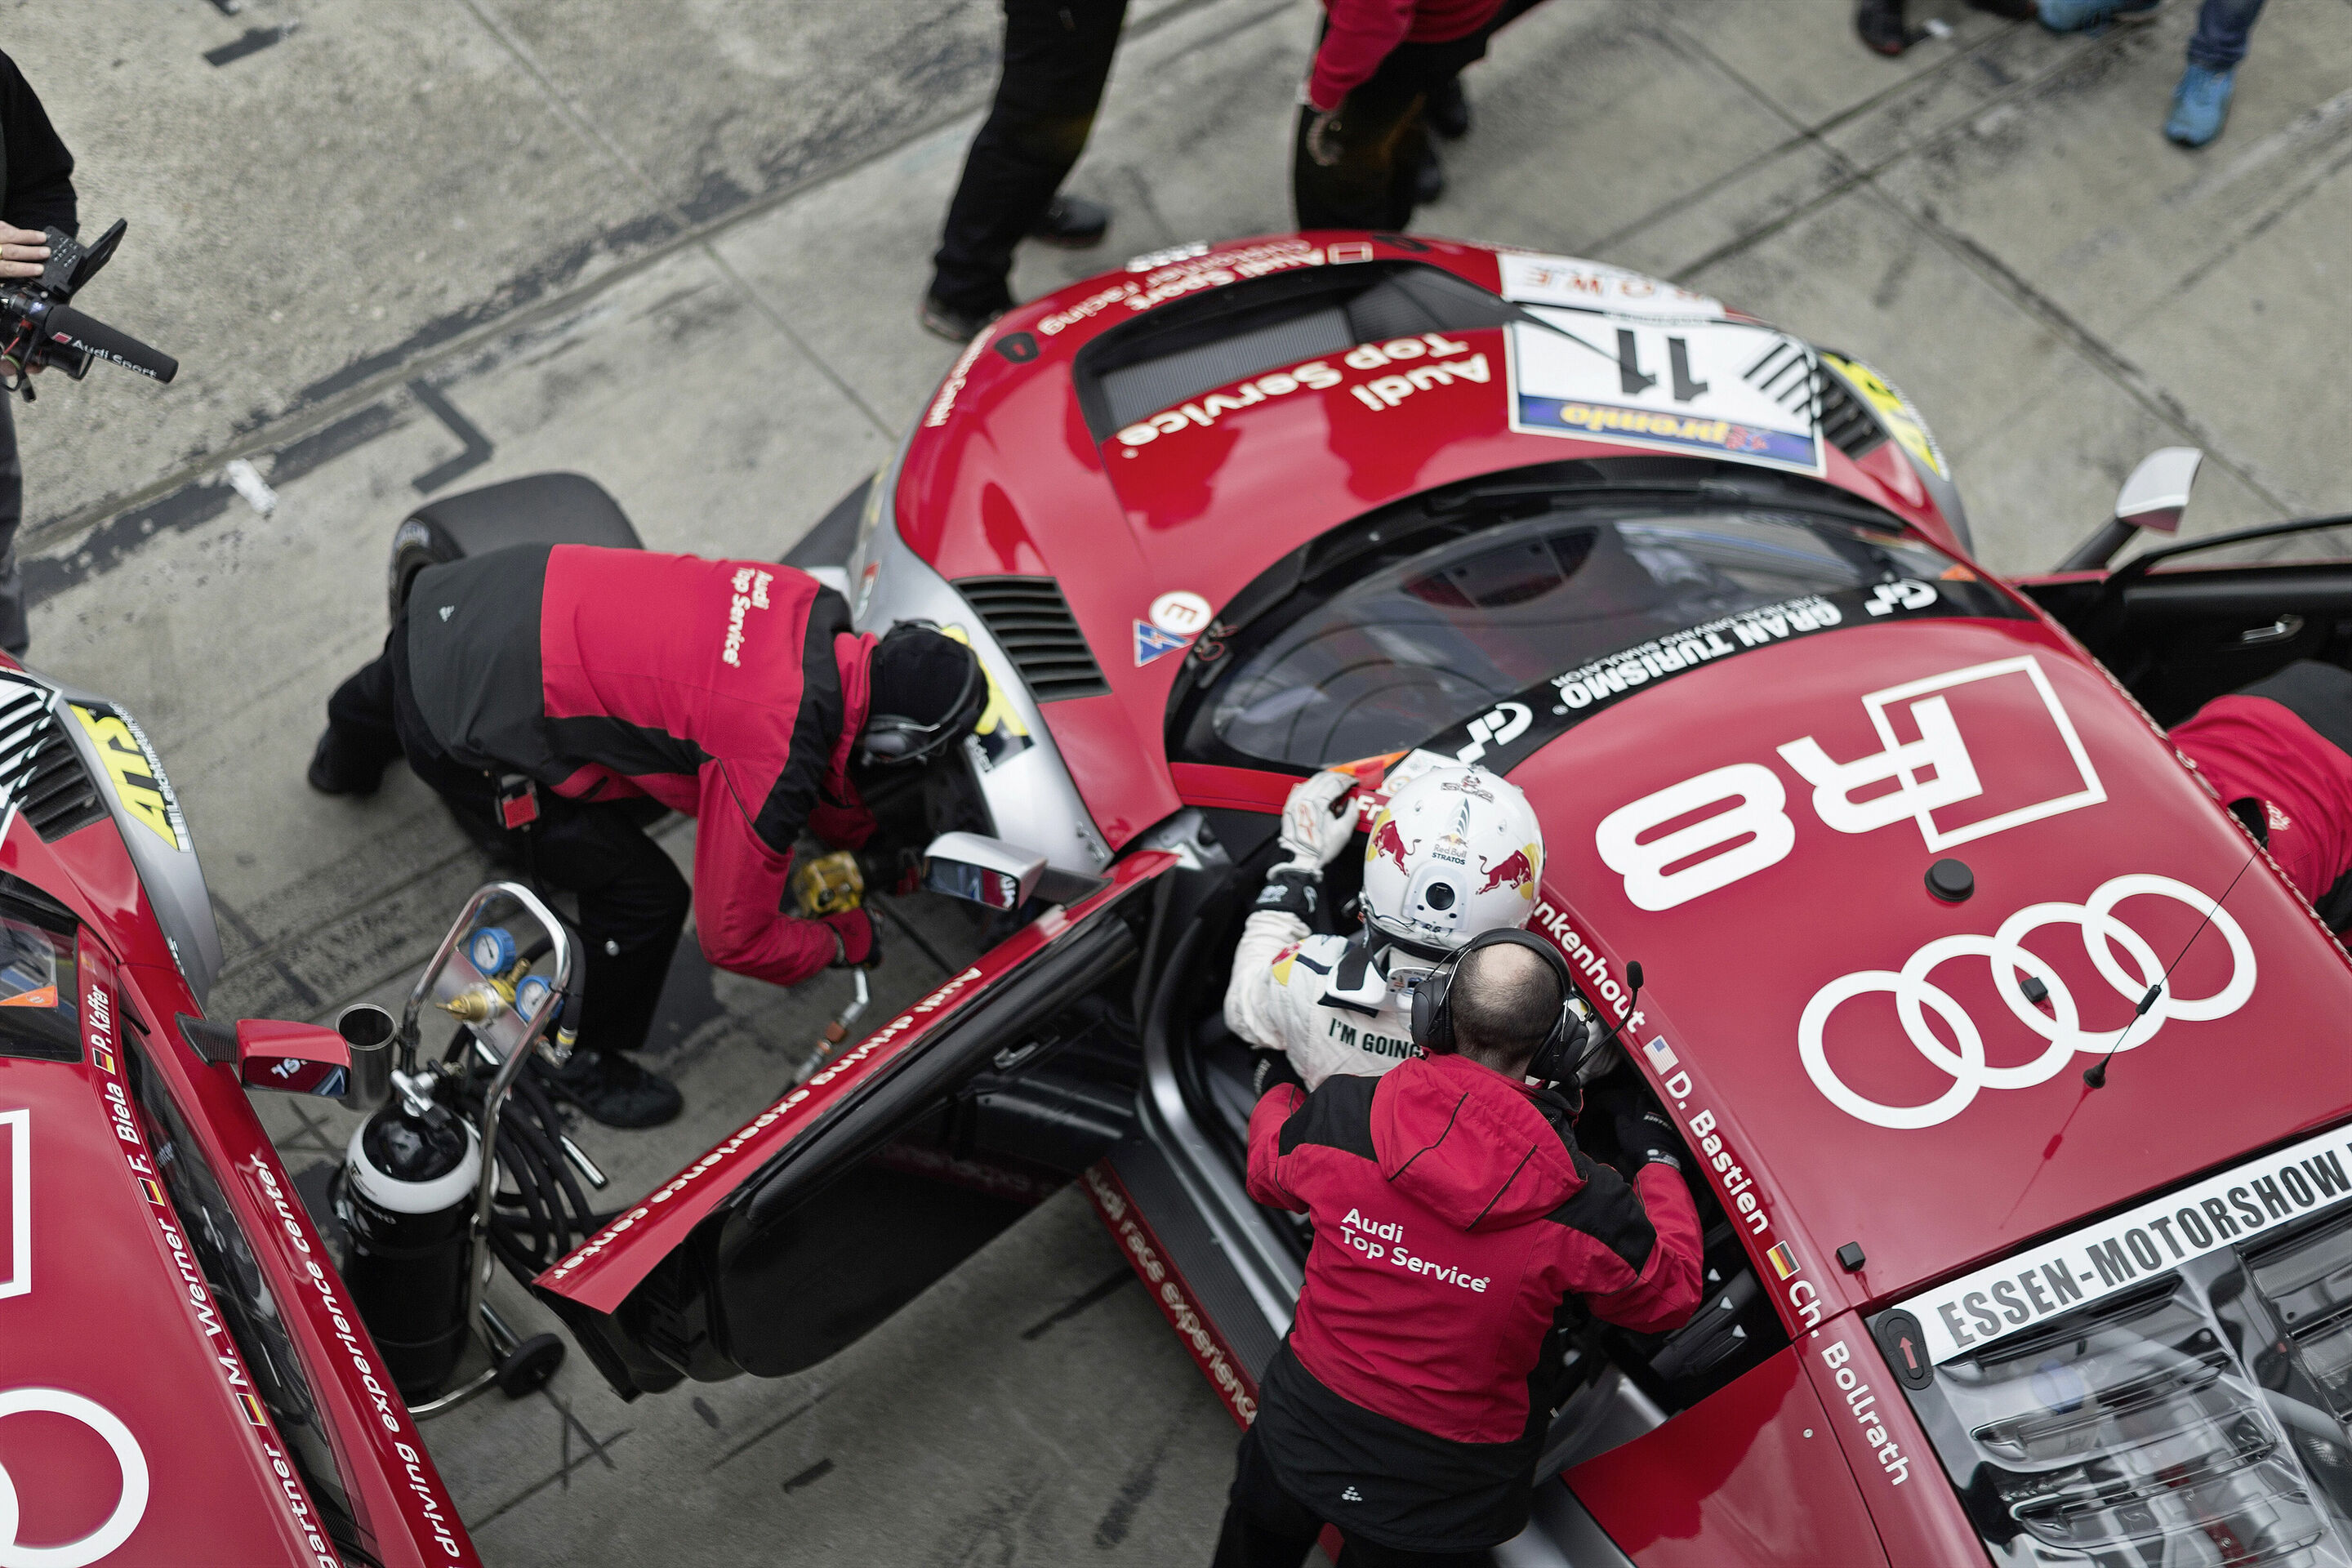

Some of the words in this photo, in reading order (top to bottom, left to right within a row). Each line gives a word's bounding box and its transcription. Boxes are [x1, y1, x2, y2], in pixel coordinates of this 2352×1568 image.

[74, 339, 109, 362] Audi
[112, 353, 158, 379] Sport
[1343, 332, 1471, 371] Top
[1349, 352, 1491, 412] Audi
[1616, 327, 1710, 402] 11
[1116, 359, 1344, 449] Service
[1559, 403, 1729, 445] premio
[732, 568, 756, 594] Top
[752, 569, 774, 611] Audi
[1733, 601, 1842, 648] GRAN
[1558, 633, 1736, 710] TURISMO
[69, 703, 180, 851] ATS
[1595, 694, 1983, 913] R8
[1432, 852, 1466, 866] STRATOS
[1433, 843, 1451, 855] Red
[1450, 848, 1468, 859] Bull
[911, 966, 983, 1015] Audi
[1532, 897, 1648, 1035] nkenhout
[87, 985, 111, 1031] Kaffer
[93, 1031, 113, 1054] P.
[808, 1015, 914, 1087] driving
[105, 1081, 140, 1144] Biela
[650, 1088, 811, 1205] experience
[131, 1152, 153, 1174] F.
[1663, 1069, 1694, 1111] D.
[1687, 1107, 1770, 1237] Bastien
[249, 1152, 312, 1254] center
[1085, 1166, 1127, 1222] udi
[1119, 1219, 1166, 1283] race
[1340, 1207, 1404, 1245] Audi
[158, 1217, 222, 1338] Werner
[554, 1205, 649, 1281] center
[1339, 1225, 1385, 1260] Top
[1391, 1246, 1488, 1294] Service
[1936, 1148, 2352, 1349] ESSEN-MOTORSHOW
[217, 1348, 249, 1386] M.
[305, 1260, 401, 1433] experience
[1788, 1279, 1822, 1339] Ch.
[1820, 1339, 1909, 1486] Bollrath
[394, 1442, 461, 1558] driving
